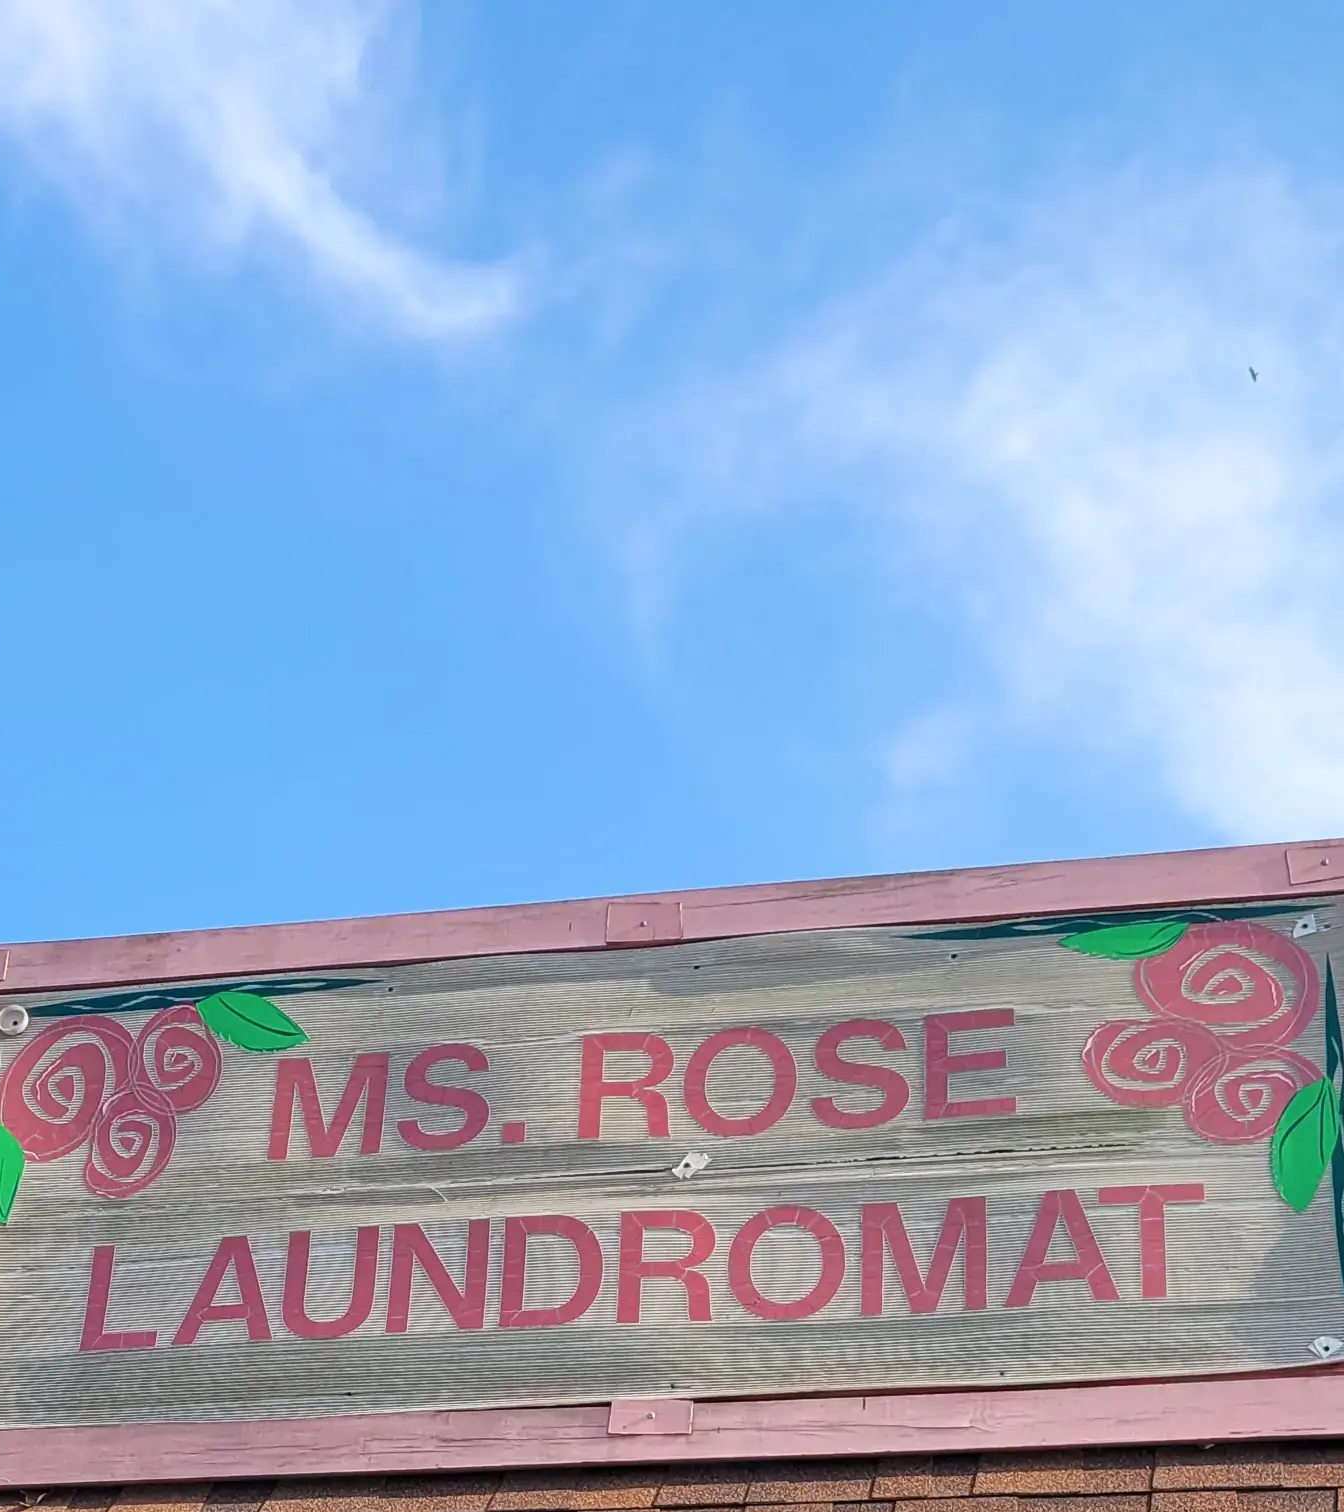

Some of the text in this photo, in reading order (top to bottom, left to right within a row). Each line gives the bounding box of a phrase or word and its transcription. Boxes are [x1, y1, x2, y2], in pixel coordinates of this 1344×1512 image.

[265, 1007, 1018, 1161] MS. ROSE
[78, 1183, 1206, 1353] LAUNDROMAT
